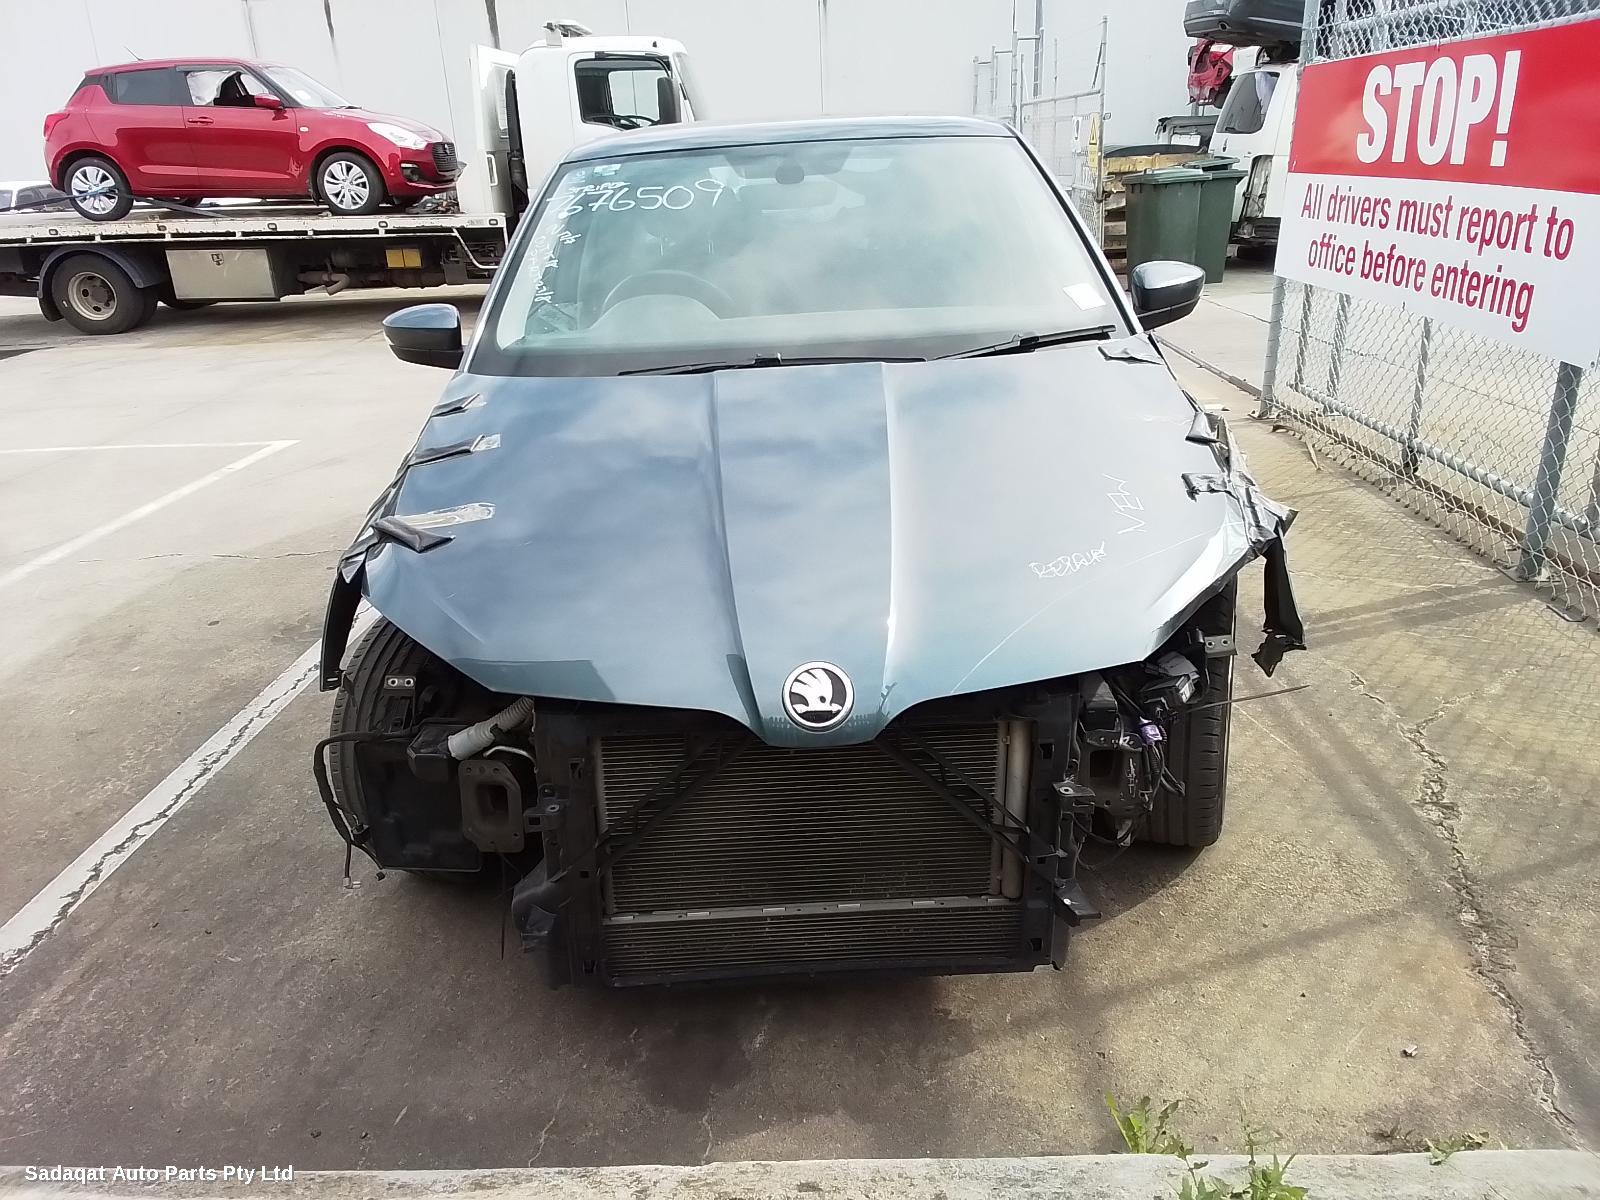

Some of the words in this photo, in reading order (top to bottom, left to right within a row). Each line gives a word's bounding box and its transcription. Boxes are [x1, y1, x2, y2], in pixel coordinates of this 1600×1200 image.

[1356, 50, 1522, 168] STOP!
[1301, 183, 1322, 220] All
[1327, 186, 1391, 230] drivers
[1396, 195, 1454, 239] must
[1456, 204, 1538, 256] report
[1543, 207, 1575, 261] to
[1308, 233, 1356, 277] office
[1360, 240, 1426, 293] before
[1431, 260, 1535, 333] entering
